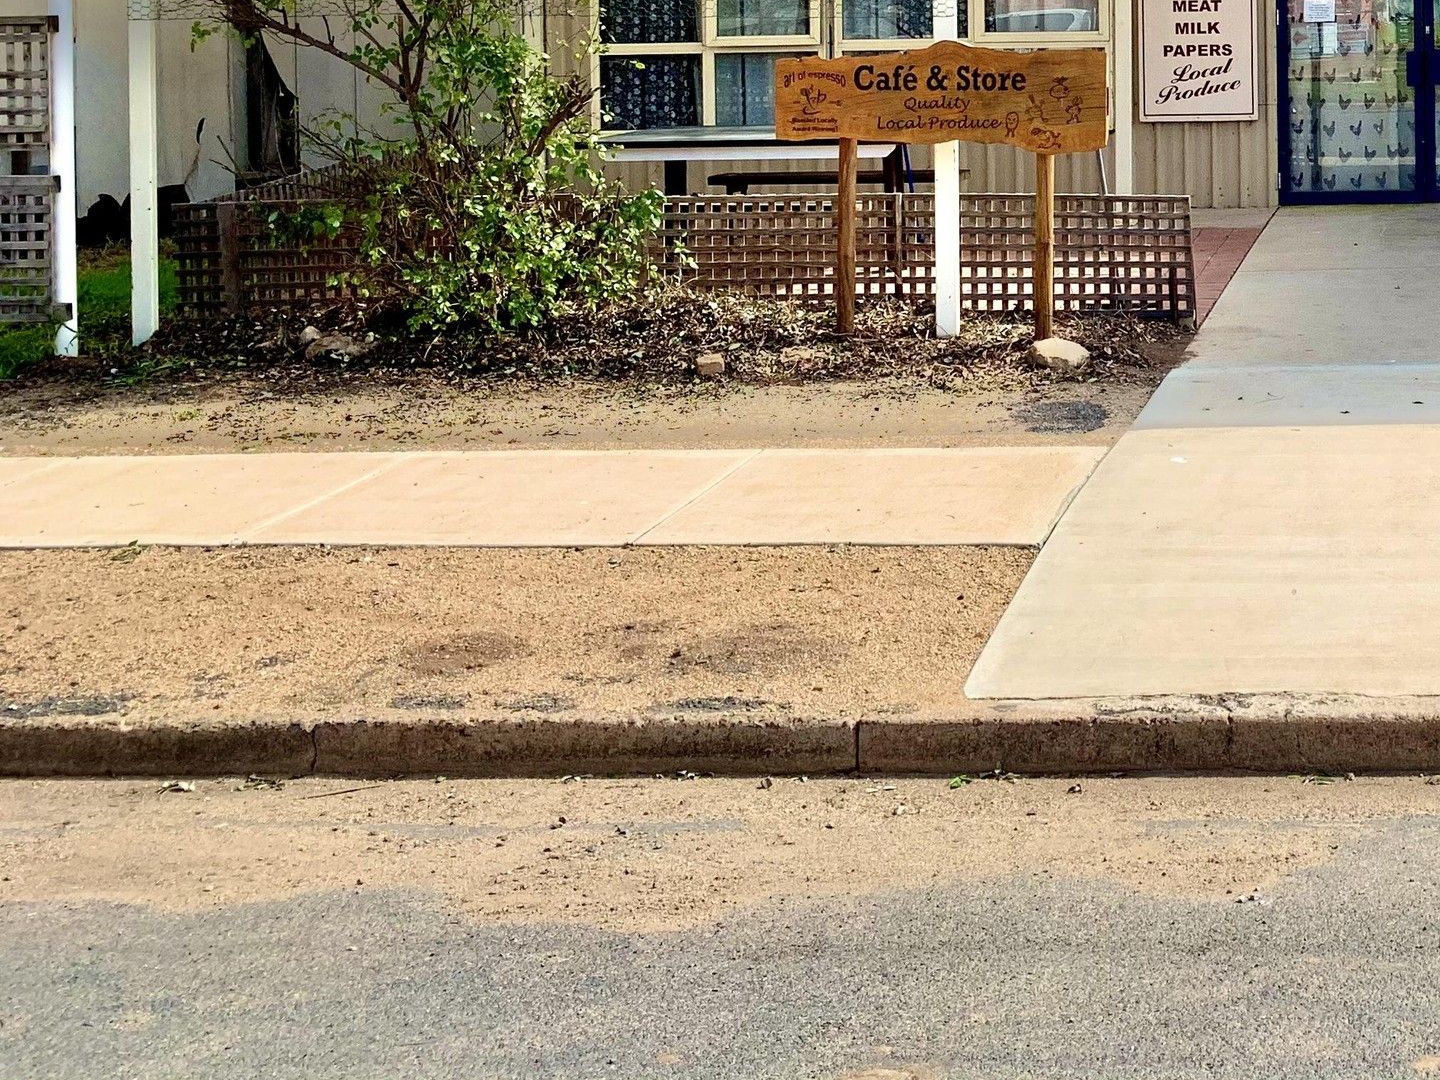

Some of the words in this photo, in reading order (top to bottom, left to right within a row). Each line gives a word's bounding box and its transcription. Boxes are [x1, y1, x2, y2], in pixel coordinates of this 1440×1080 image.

[1172, 0, 1222, 12] MEAT
[1175, 22, 1220, 34] MILK
[1163, 44, 1233, 57] PAPERS
[853, 64, 917, 91] Café
[927, 65, 949, 91] &
[957, 65, 1027, 91] Store
[1172, 58, 1235, 84] Local
[1155, 78, 1241, 105] Produce
[904, 96, 971, 113] Quality
[877, 115, 924, 130] Local
[928, 116, 1000, 130] Produce
